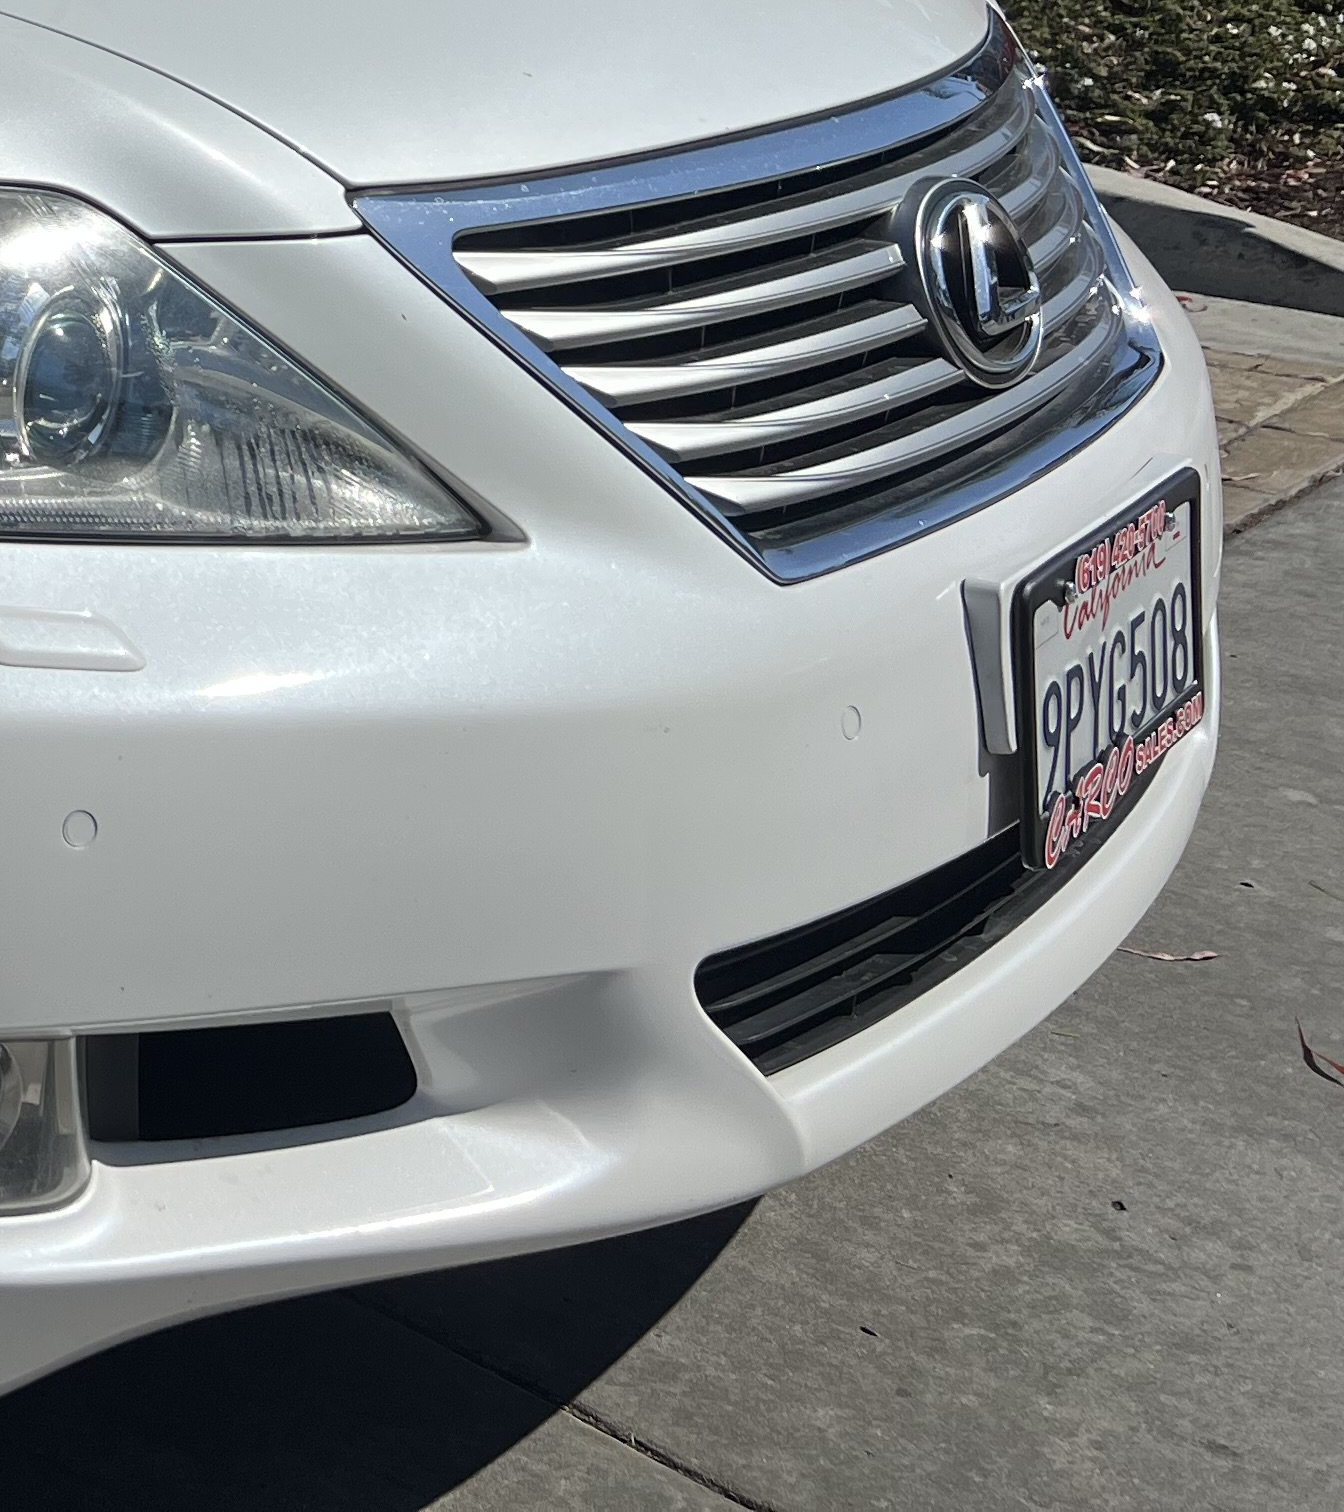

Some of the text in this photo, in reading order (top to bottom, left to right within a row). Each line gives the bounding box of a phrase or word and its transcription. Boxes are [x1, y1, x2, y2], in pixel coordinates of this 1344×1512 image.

[1064, 541, 1168, 640] California
[1074, 499, 1168, 595] (619) 420-5700
[1041, 582, 1191, 816] 9PYG508
[1044, 690, 1204, 870] CARCO SALES.COM
